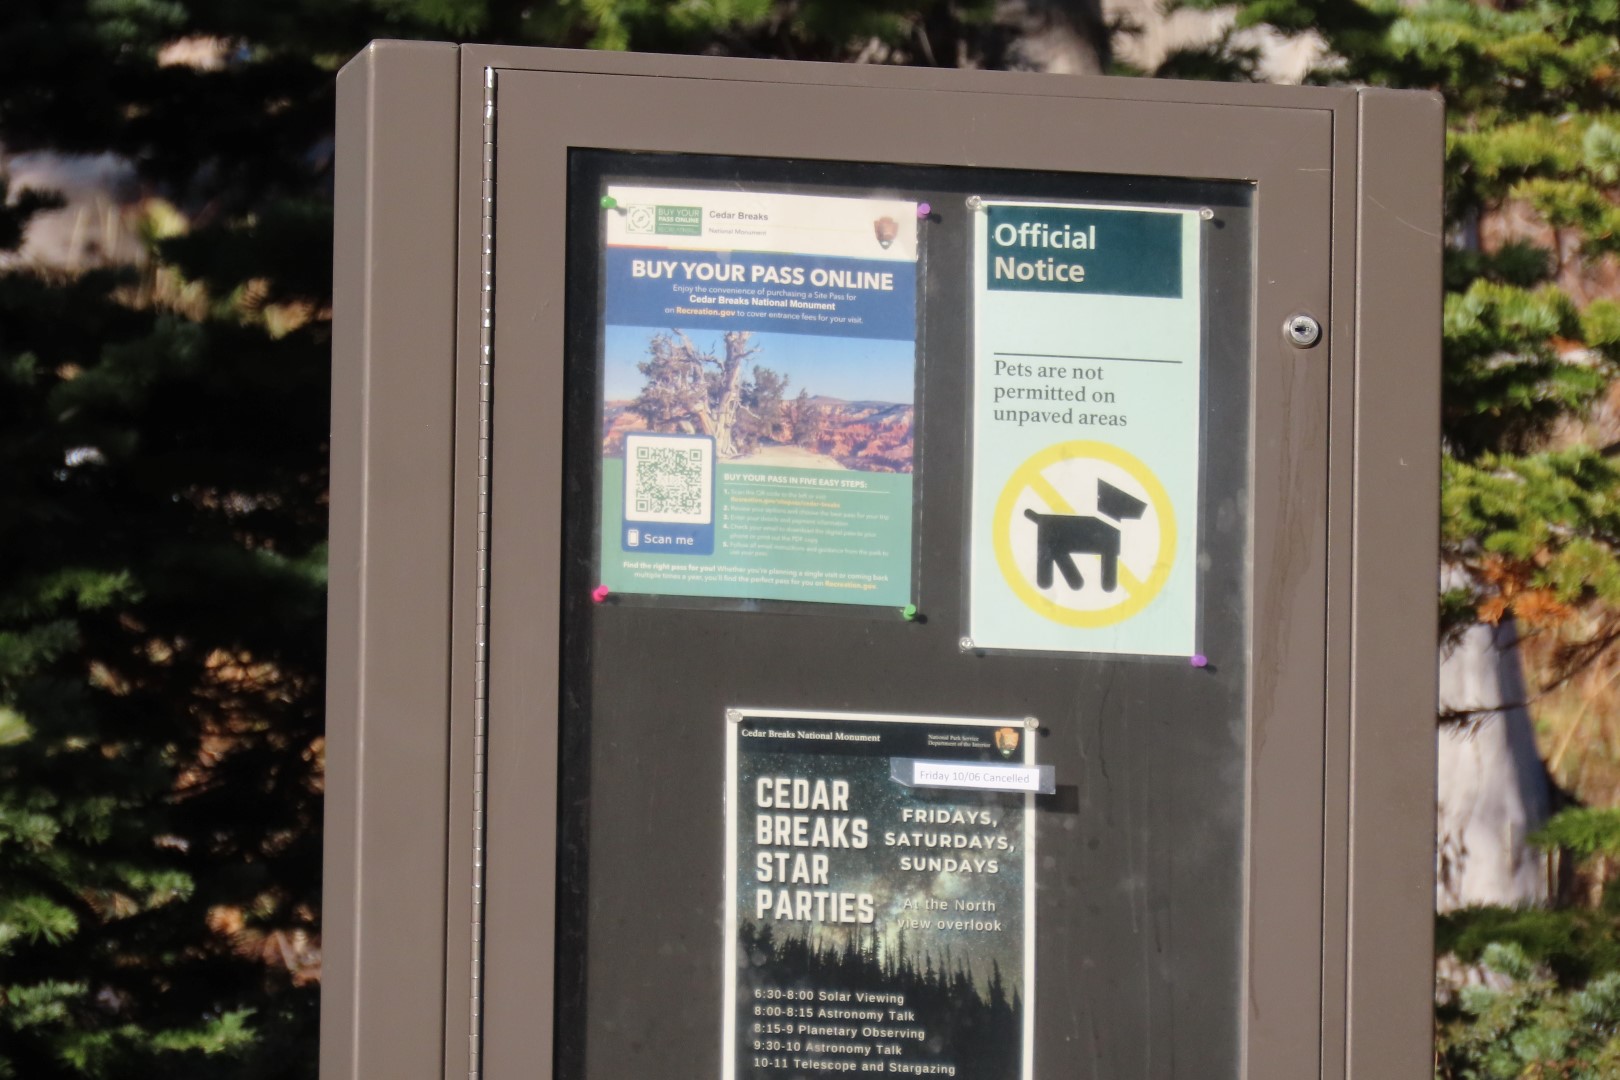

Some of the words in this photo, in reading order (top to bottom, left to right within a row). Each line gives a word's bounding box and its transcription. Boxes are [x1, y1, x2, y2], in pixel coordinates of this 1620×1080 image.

[658, 208, 674, 216] BUY
[677, 208, 700, 217] YOUR
[709, 210, 735, 220] Cedar
[738, 212, 768, 220] Breaks
[994, 222, 1096, 250] Official
[632, 260, 678, 280] BUY
[682, 262, 746, 282] YOUR
[751, 265, 804, 285] PASS
[810, 268, 894, 291] ONLINE
[994, 256, 1085, 282] Notice
[673, 284, 693, 293] Enjoy
[709, 287, 756, 295] convenience
[767, 289, 806, 299] purchasing
[689, 295, 716, 304] Cedar
[718, 296, 749, 306] Breaks
[752, 298, 788, 308] National
[790, 300, 836, 310] Monument
[676, 307, 736, 318] Recreation.gov
[769, 312, 800, 320] entrance
[830, 316, 846, 324] your
[848, 316, 864, 324] visit.
[994, 360, 1032, 377] Pets
[1038, 364, 1067, 378] are
[1072, 366, 1104, 380] not
[993, 385, 1086, 403] permitted
[1092, 391, 1116, 404] on
[994, 408, 1073, 426] unpaved
[1078, 413, 1127, 427] areas
[743, 474, 766, 482] YOUR
[768, 475, 788, 483] PASS
[819, 478, 839, 486] EASY
[840, 480, 867, 488] STEPS:
[644, 533, 672, 546] Scan
[676, 536, 694, 546] me
[653, 562, 670, 571] right
[741, 729, 766, 738] Cedar
[768, 730, 796, 739] Breaks
[798, 731, 833, 741] National
[835, 732, 881, 742] Monument
[920, 770, 949, 782] Friday
[953, 772, 980, 782] 10/06
[983, 774, 1030, 783] Cancelled
[756, 776, 850, 811] CEDAR
[902, 808, 998, 827] FRIDAYS,
[756, 815, 868, 849] BREAKS
[885, 832, 1016, 852] SATURDAYS,
[756, 852, 829, 885] STAR
[900, 857, 999, 874] SUNDAYS
[756, 888, 874, 924] PARTIES
[903, 898, 920, 911] At
[925, 898, 948, 912] the
[955, 900, 996, 913] North
[897, 918, 931, 930] view
[937, 919, 1002, 932] overlook
[755, 989, 814, 1001] 6:30-8:00
[818, 991, 851, 1002] Solar
[856, 992, 904, 1006] Viewing
[754, 1007, 814, 1018] 8:00-8:15
[818, 1008, 884, 1023] Astronomy
[889, 1010, 915, 1022] Talk
[754, 1024, 794, 1035] 8:15-9
[798, 1025, 858, 1039] Planetary
[862, 1027, 925, 1041] Observing
[754, 1040, 801, 1052] 9:30-10
[805, 1042, 871, 1056] Astronomy
[876, 1044, 902, 1055] Talk
[754, 1058, 788, 1069] 10-11
[794, 1059, 857, 1073] Telescope
[862, 1062, 884, 1073] and
[889, 1063, 956, 1076] Stargazing
